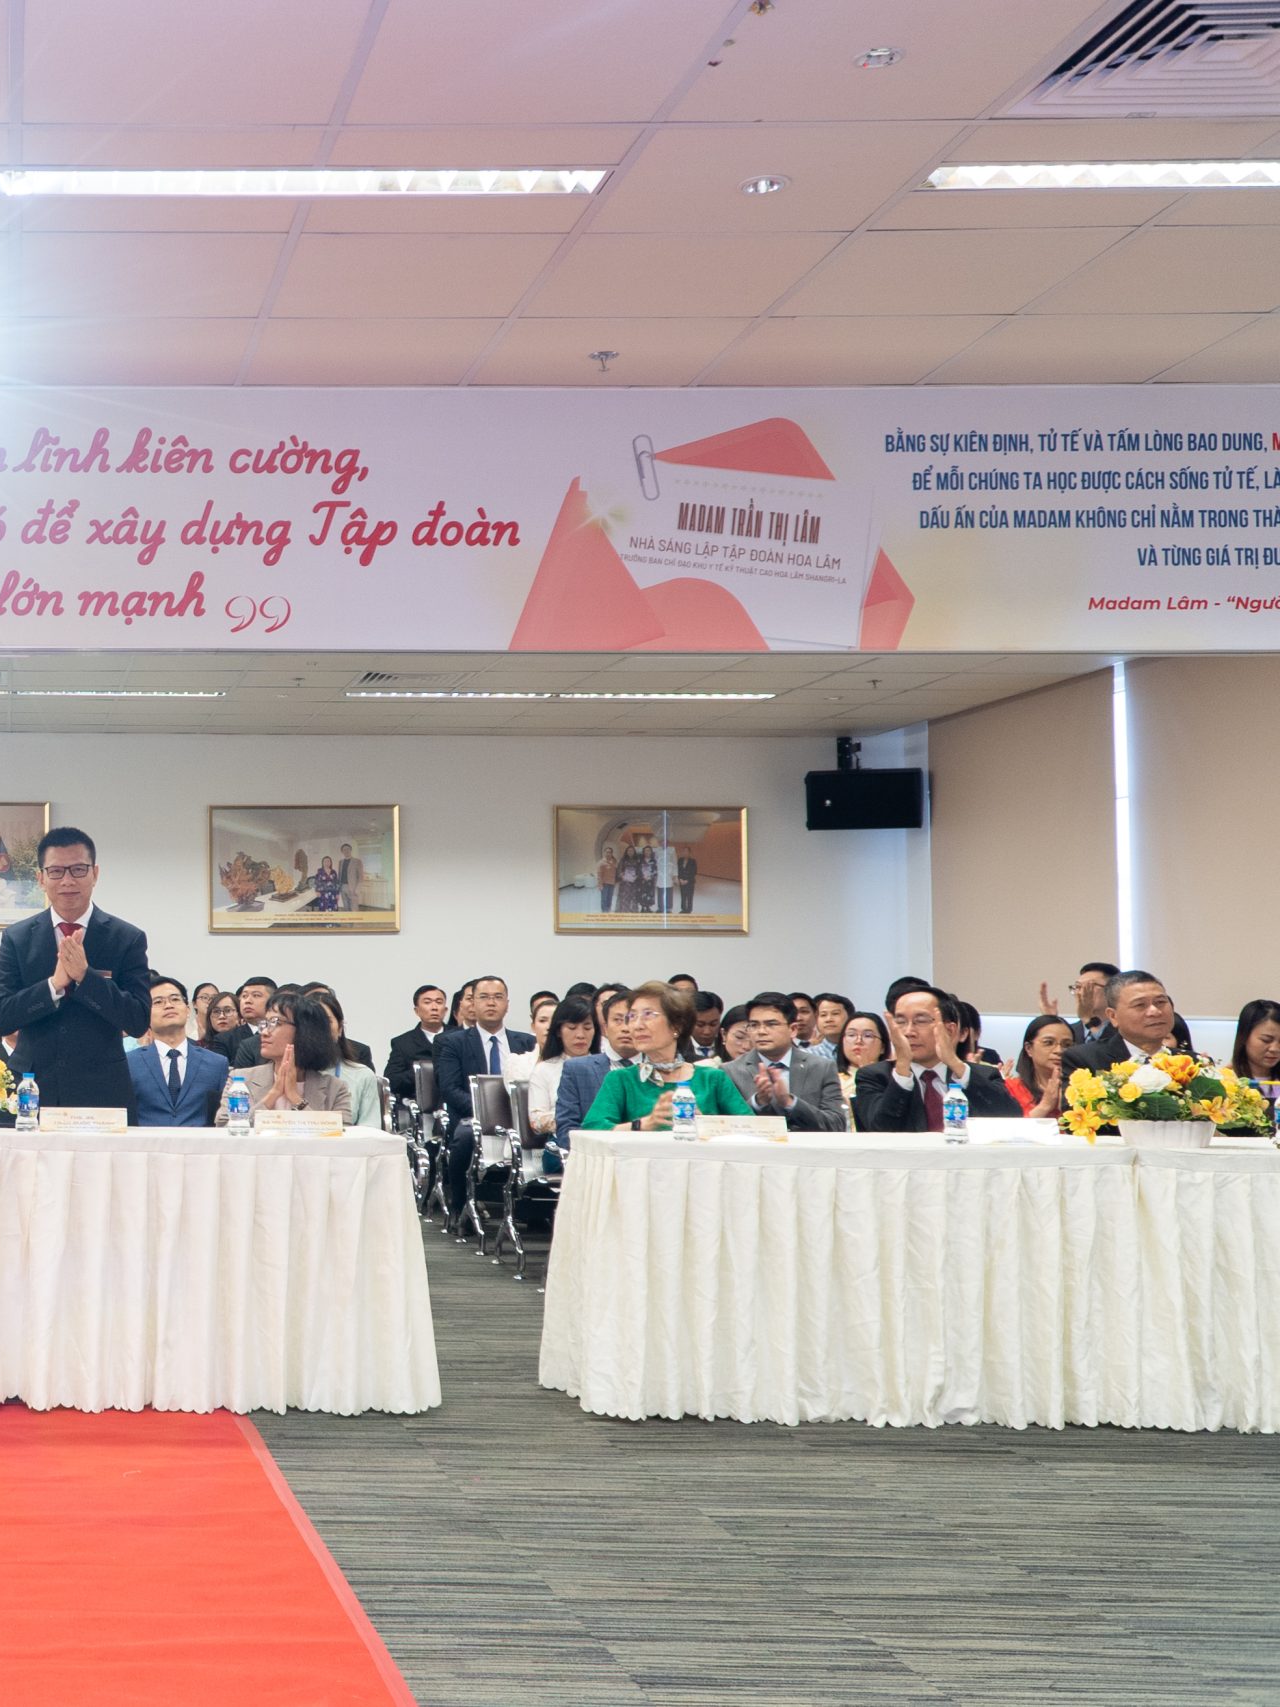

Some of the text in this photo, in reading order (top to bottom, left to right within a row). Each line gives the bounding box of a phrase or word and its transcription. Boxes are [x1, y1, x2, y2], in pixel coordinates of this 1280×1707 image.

[885, 427, 926, 452] BẰNG
[930, 433, 950, 456] SỰ
[954, 430, 988, 452] KIÊN
[992, 434, 1034, 455] ĐỊNH,
[1038, 428, 1058, 452] TỬ
[1061, 428, 1082, 452] TẾ
[1083, 428, 1103, 452] VÀ
[1107, 427, 1140, 452] TẤM
[1144, 428, 1183, 452] LÒNG
[1188, 433, 1217, 451] BAO
[1222, 433, 1267, 453] DUNG,
[13, 427, 110, 474] lĩnh
[116, 427, 214, 474] kiên
[229, 435, 370, 495] cường,
[912, 465, 934, 490] ĐỂ
[936, 465, 964, 490] MỖI
[968, 468, 1019, 490] CHÚNG
[1023, 472, 1043, 490] TA
[1047, 471, 1077, 493] HỌC
[1081, 470, 1121, 494] ĐƯỢC
[1125, 466, 1164, 490] CÁCH
[1169, 466, 1209, 489] SỐNG
[1213, 465, 1233, 489] TỬ
[1236, 465, 1260, 491] TẾ,
[677, 498, 821, 546] MADAM TRẦN THỊ LÂM
[920, 505, 950, 529] DẤU
[954, 505, 975, 529] ẤN
[979, 505, 1009, 528] CỦA
[1013, 510, 1071, 528] MADAM
[1075, 506, 1126, 528] KHÔNG
[1131, 504, 1156, 528] CHỈ
[1160, 503, 1194, 528] NẰM
[1198, 509, 1249, 528] TRONG
[20, 498, 81, 545] để
[86, 506, 166, 565] xây
[180, 499, 291, 566] dựng
[308, 500, 398, 567] Tập
[411, 500, 520, 547] đoàn
[629, 536, 841, 570] NHÀ SÁNG LẬP TẬP ĐOÀN HOA LÂM
[1137, 544, 1158, 566] VÀ
[1161, 543, 1201, 566] TỪNG
[1206, 544, 1231, 566] GIÁ
[1234, 547, 1259, 569] TRỊ
[78, 571, 206, 625] mạnh
[1088, 596, 1163, 610] Madam
[1166, 596, 1208, 610] Lâm
